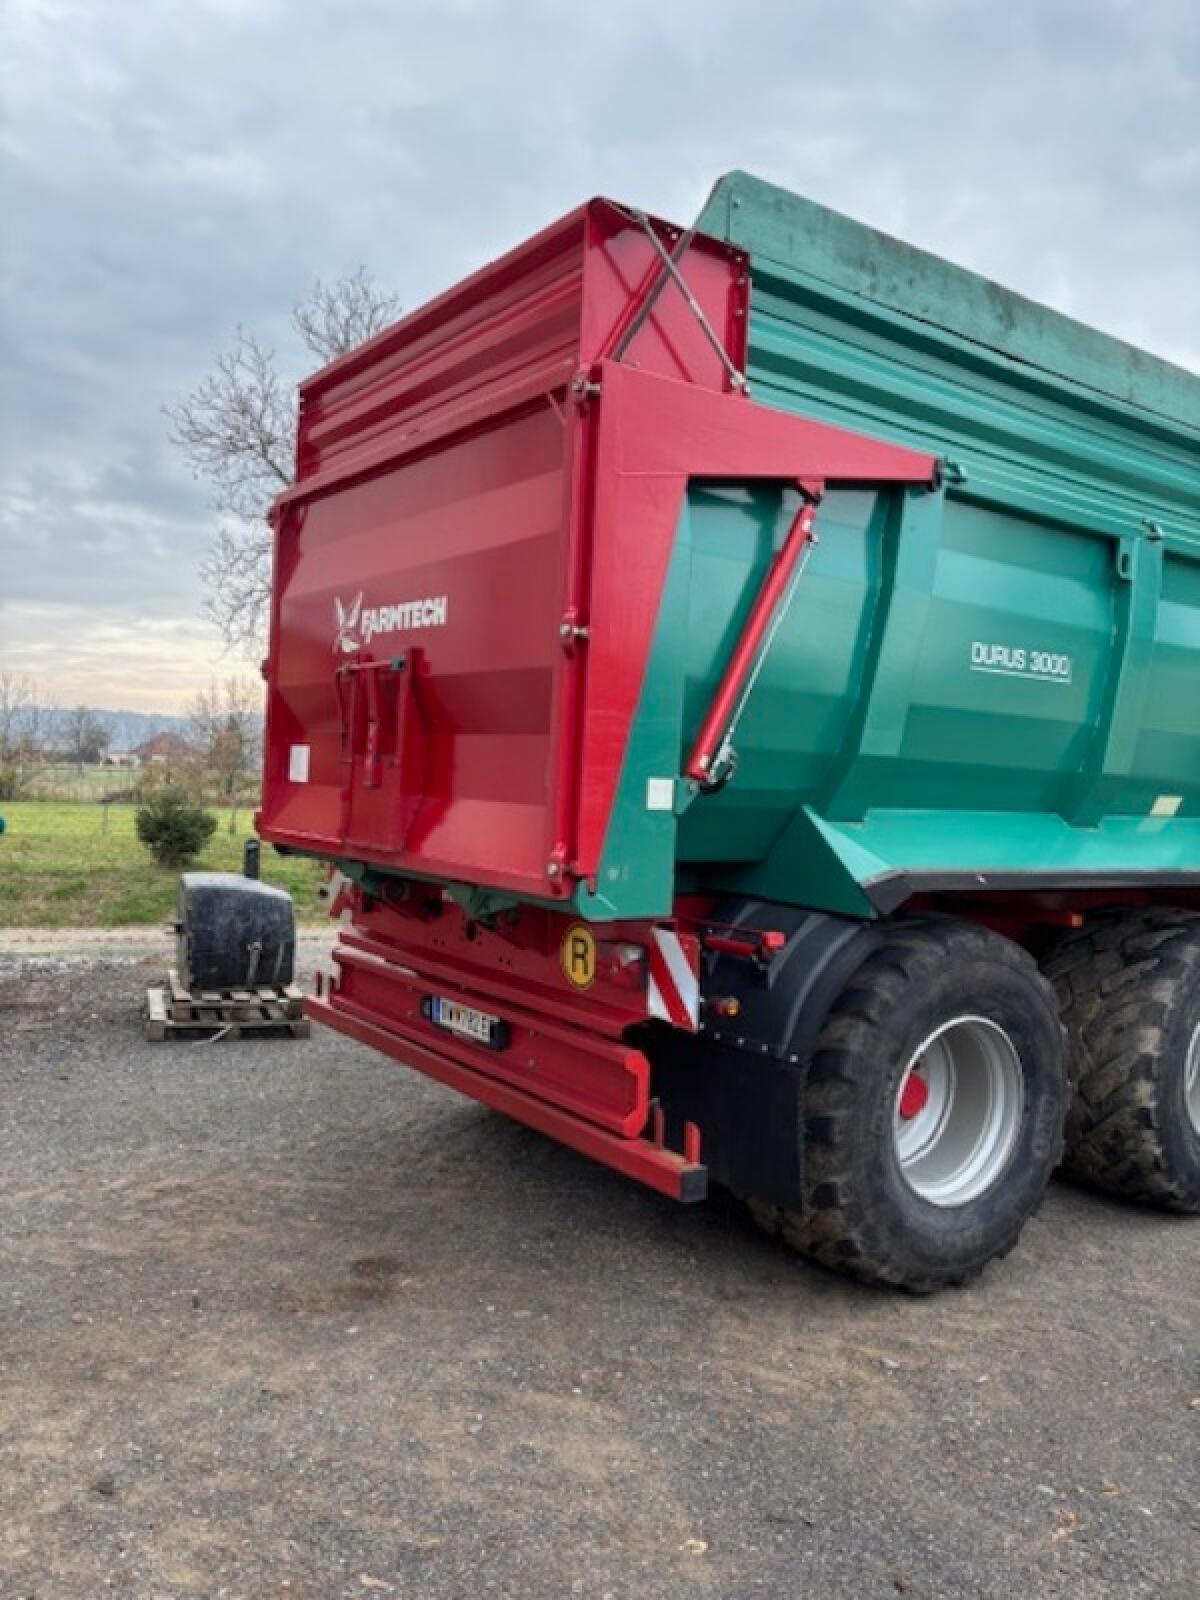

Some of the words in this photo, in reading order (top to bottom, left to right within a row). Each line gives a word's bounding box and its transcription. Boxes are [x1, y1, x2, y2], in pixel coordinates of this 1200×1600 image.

[361, 595, 448, 635] FARMTECH
[971, 641, 1025, 670] DURUS
[1030, 651, 1069, 675] 3000
[571, 936, 589, 976] R
